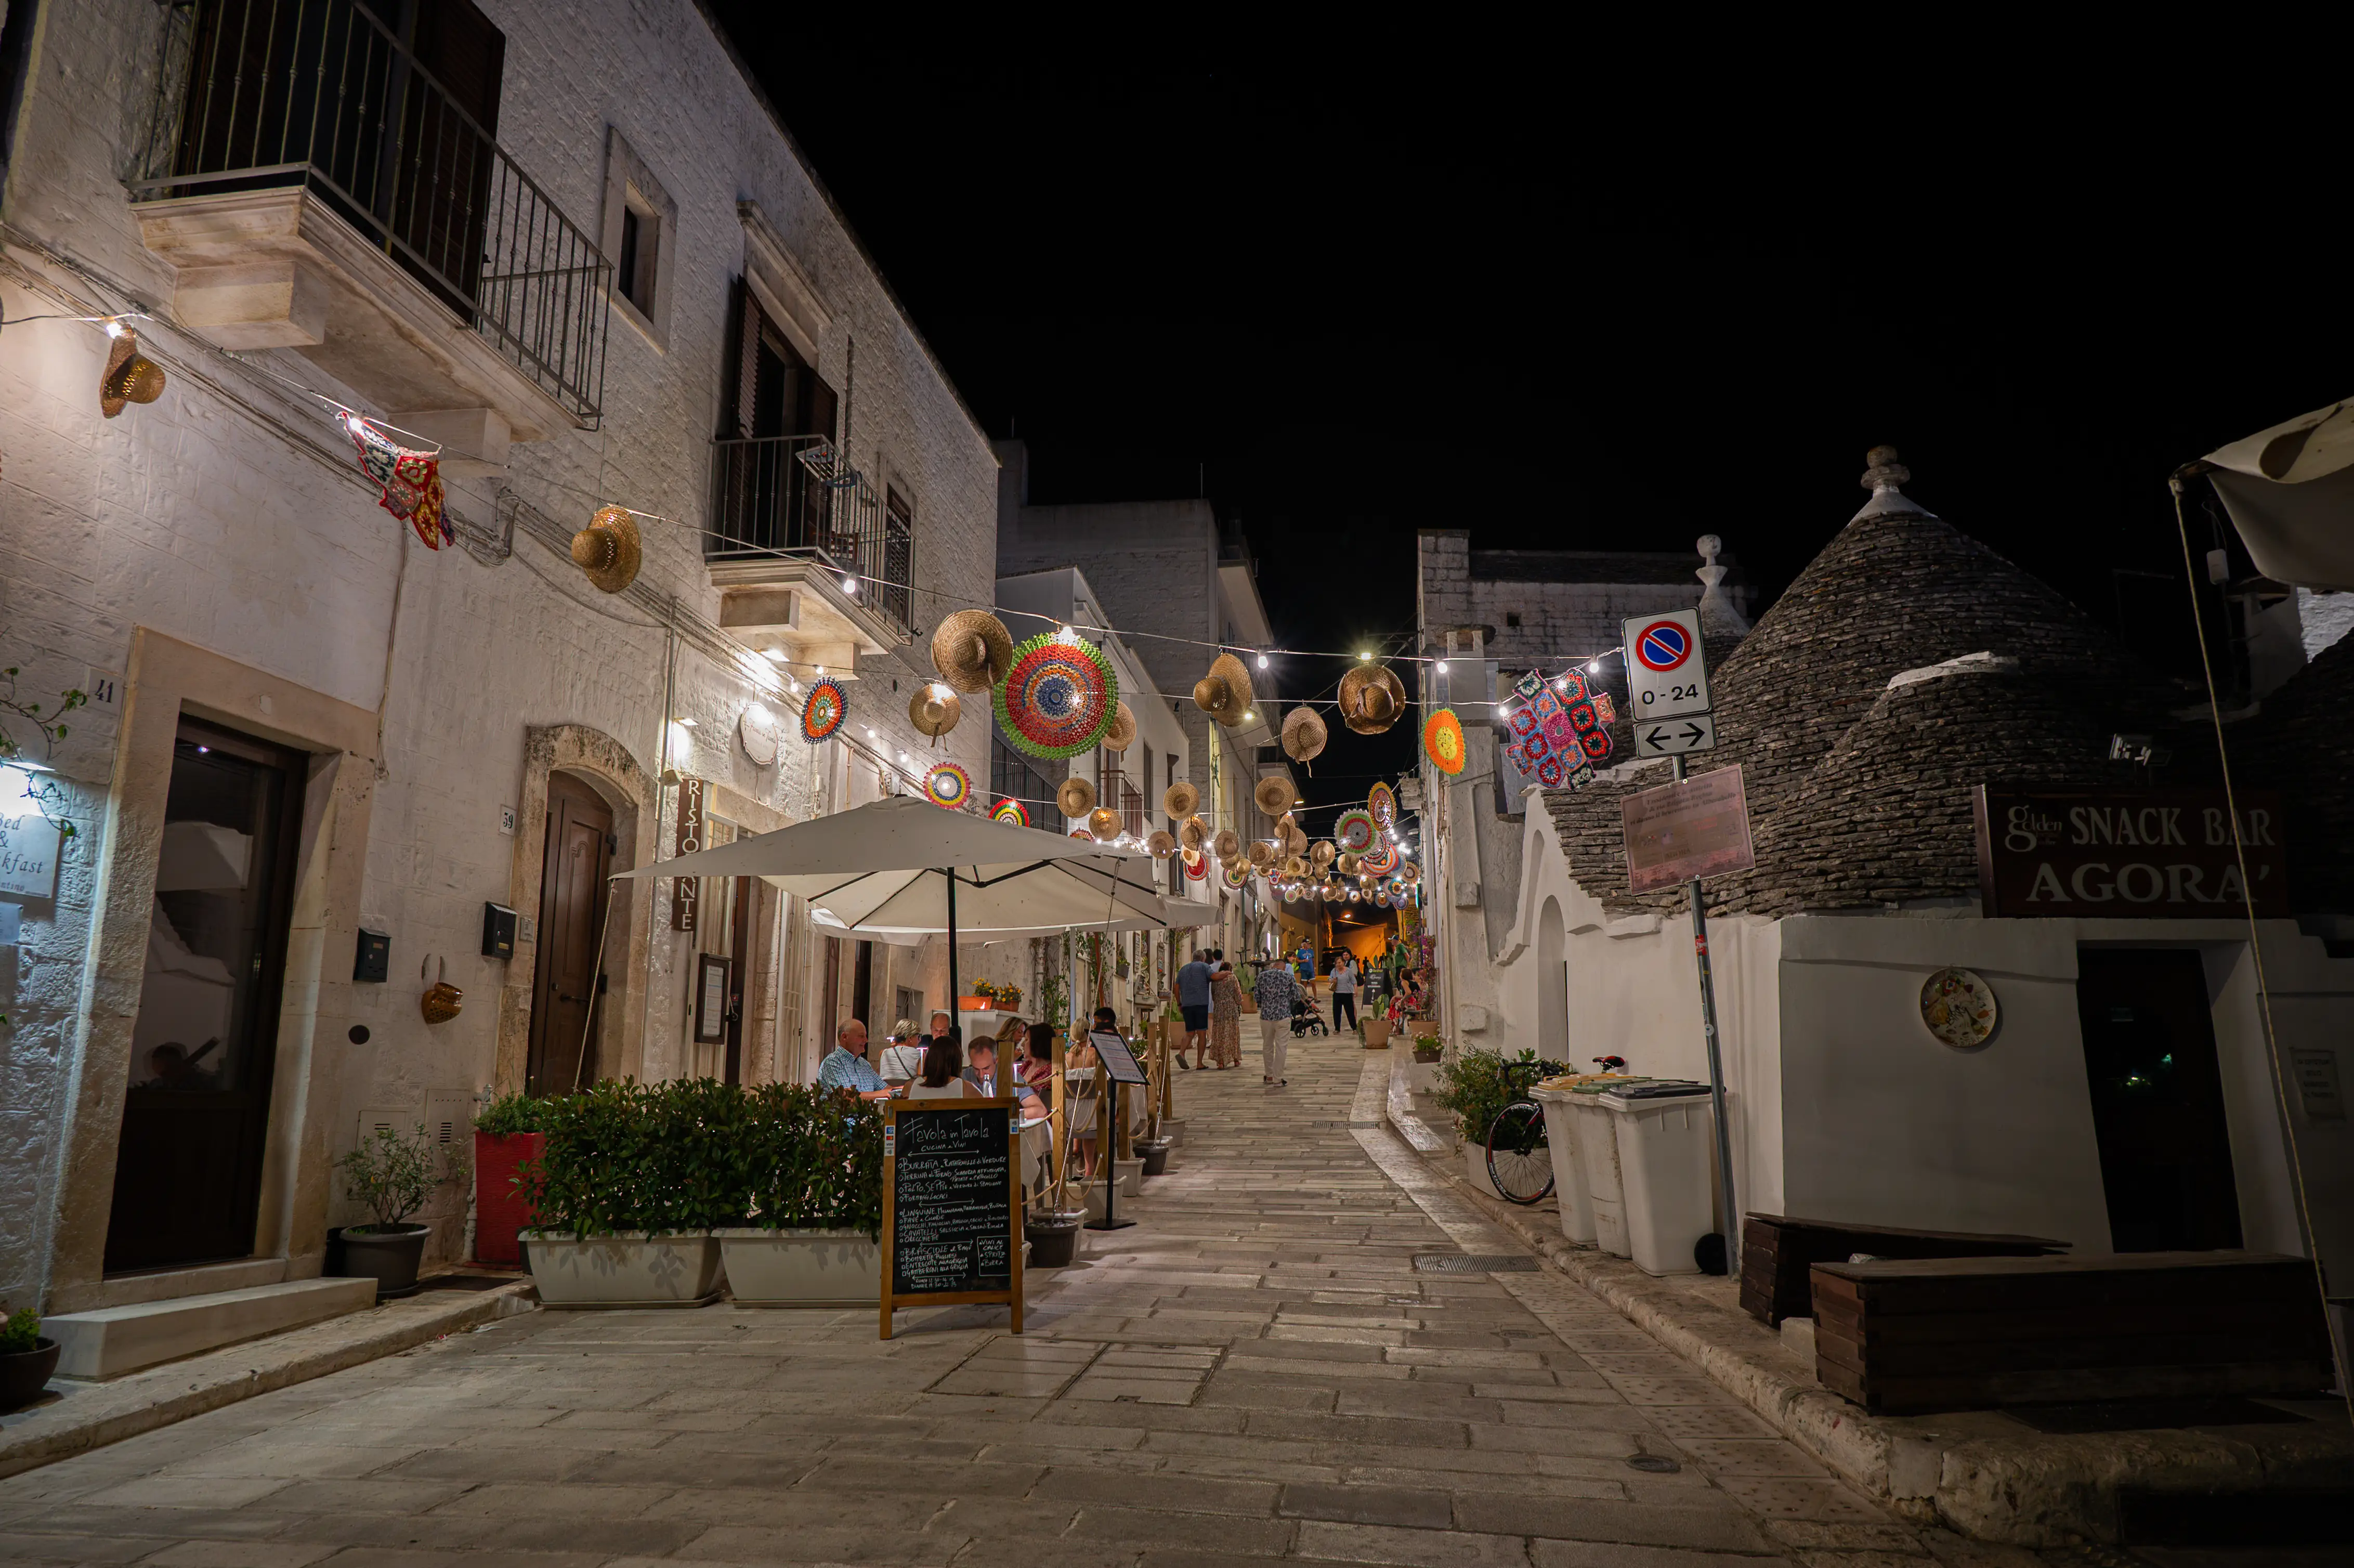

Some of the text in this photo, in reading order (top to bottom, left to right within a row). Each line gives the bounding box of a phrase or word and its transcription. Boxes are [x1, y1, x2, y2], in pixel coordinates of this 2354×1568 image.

[95, 679, 113, 703] 41
[1642, 690, 1655, 705] 0
[1671, 684, 1698, 701] 24
[503, 812, 514, 829] 39
[2004, 804, 2062, 853] golden
[2070, 806, 2276, 846] SNACK BAR
[0, 852, 43, 874] kfast
[680, 780, 701, 929] RISTONTE
[2026, 862, 2270, 903] AGORA'
[903, 1117, 947, 1143] Favola
[954, 1114, 989, 1139] Tavola
[899, 1158, 938, 1171] BURRATA
[901, 1171, 927, 1182] TERRINA
[905, 1235, 939, 1243] ORECCHIETTE
[904, 1244, 948, 1256] BRASCIOLE
[906, 1260, 937, 1270] ENTRECOTE
[906, 1266, 938, 1277] GAMBERONI
[949, 1263, 969, 1272] GRIGLIA
